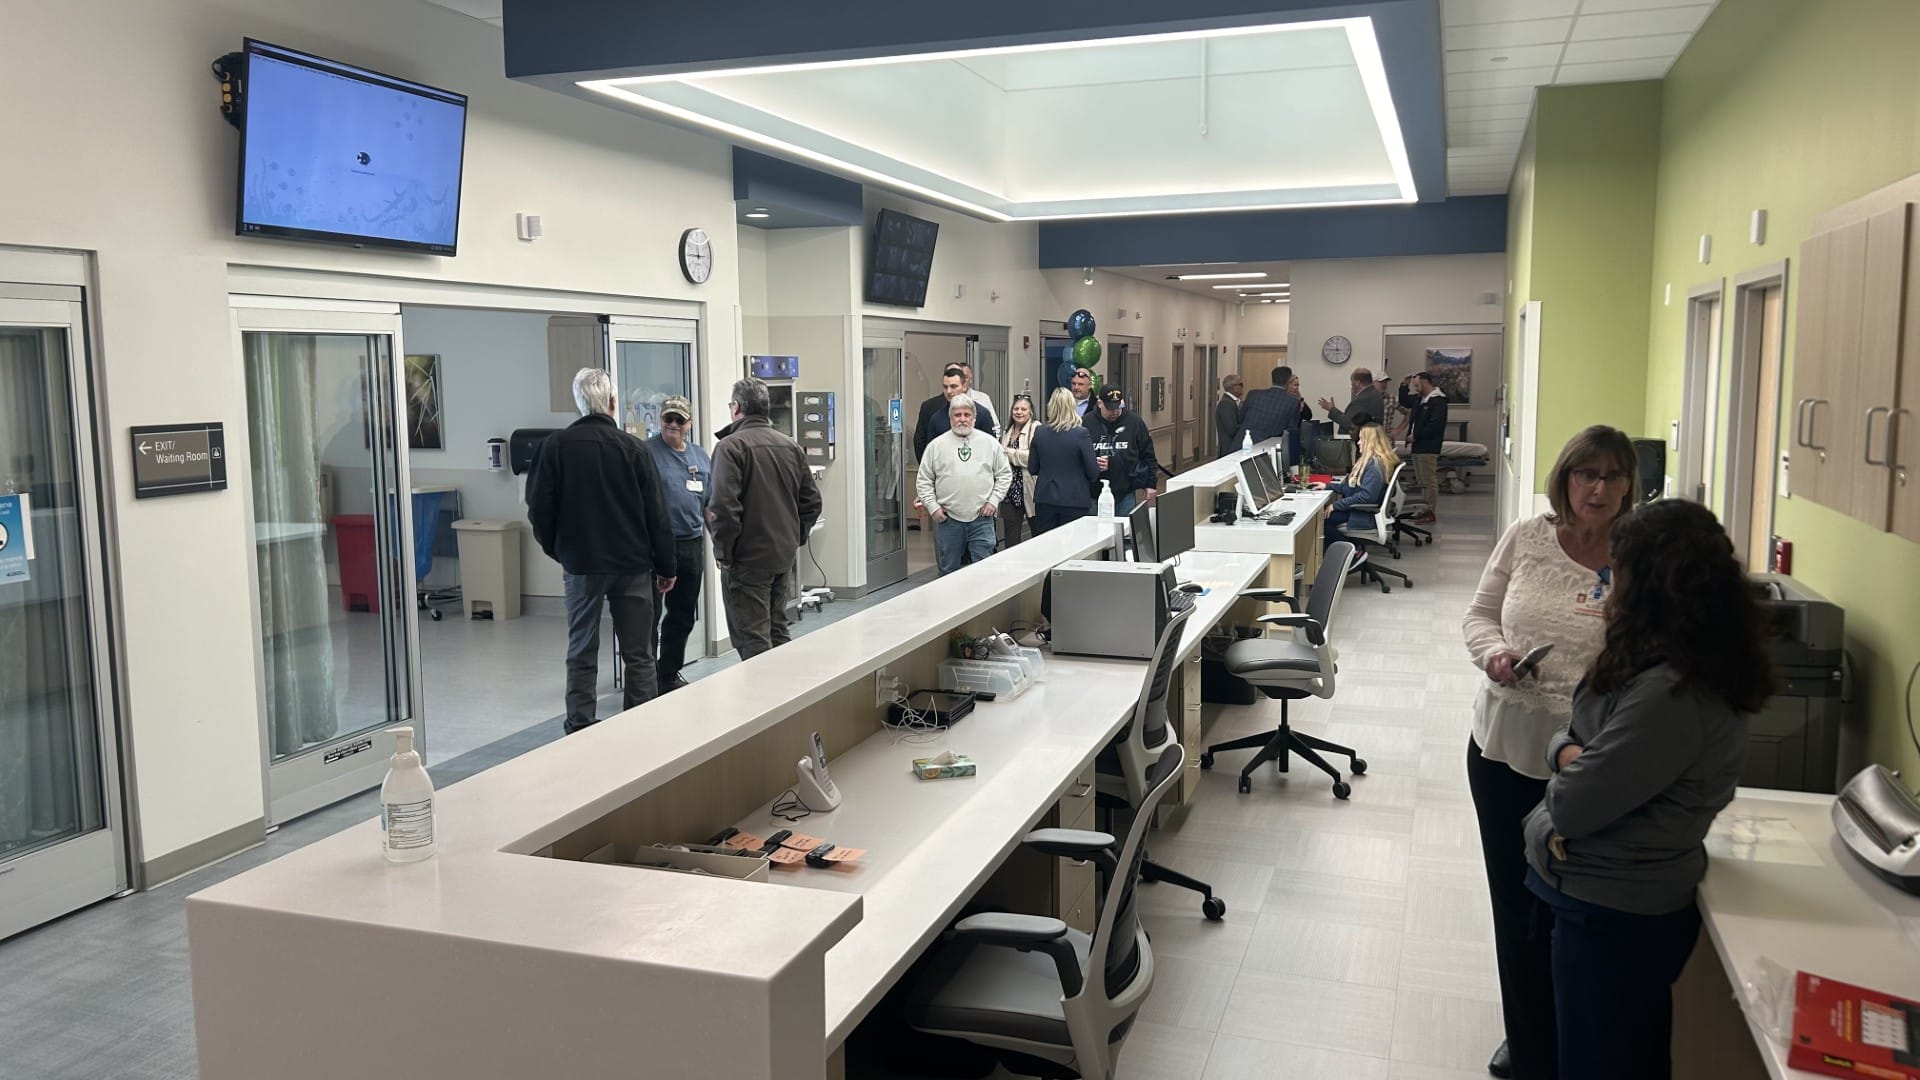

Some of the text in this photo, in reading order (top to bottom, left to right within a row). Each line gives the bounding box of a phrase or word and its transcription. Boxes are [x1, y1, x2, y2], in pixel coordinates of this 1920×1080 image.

[154, 440, 176, 451] EXIT/
[155, 451, 208, 464] Waiting Room
